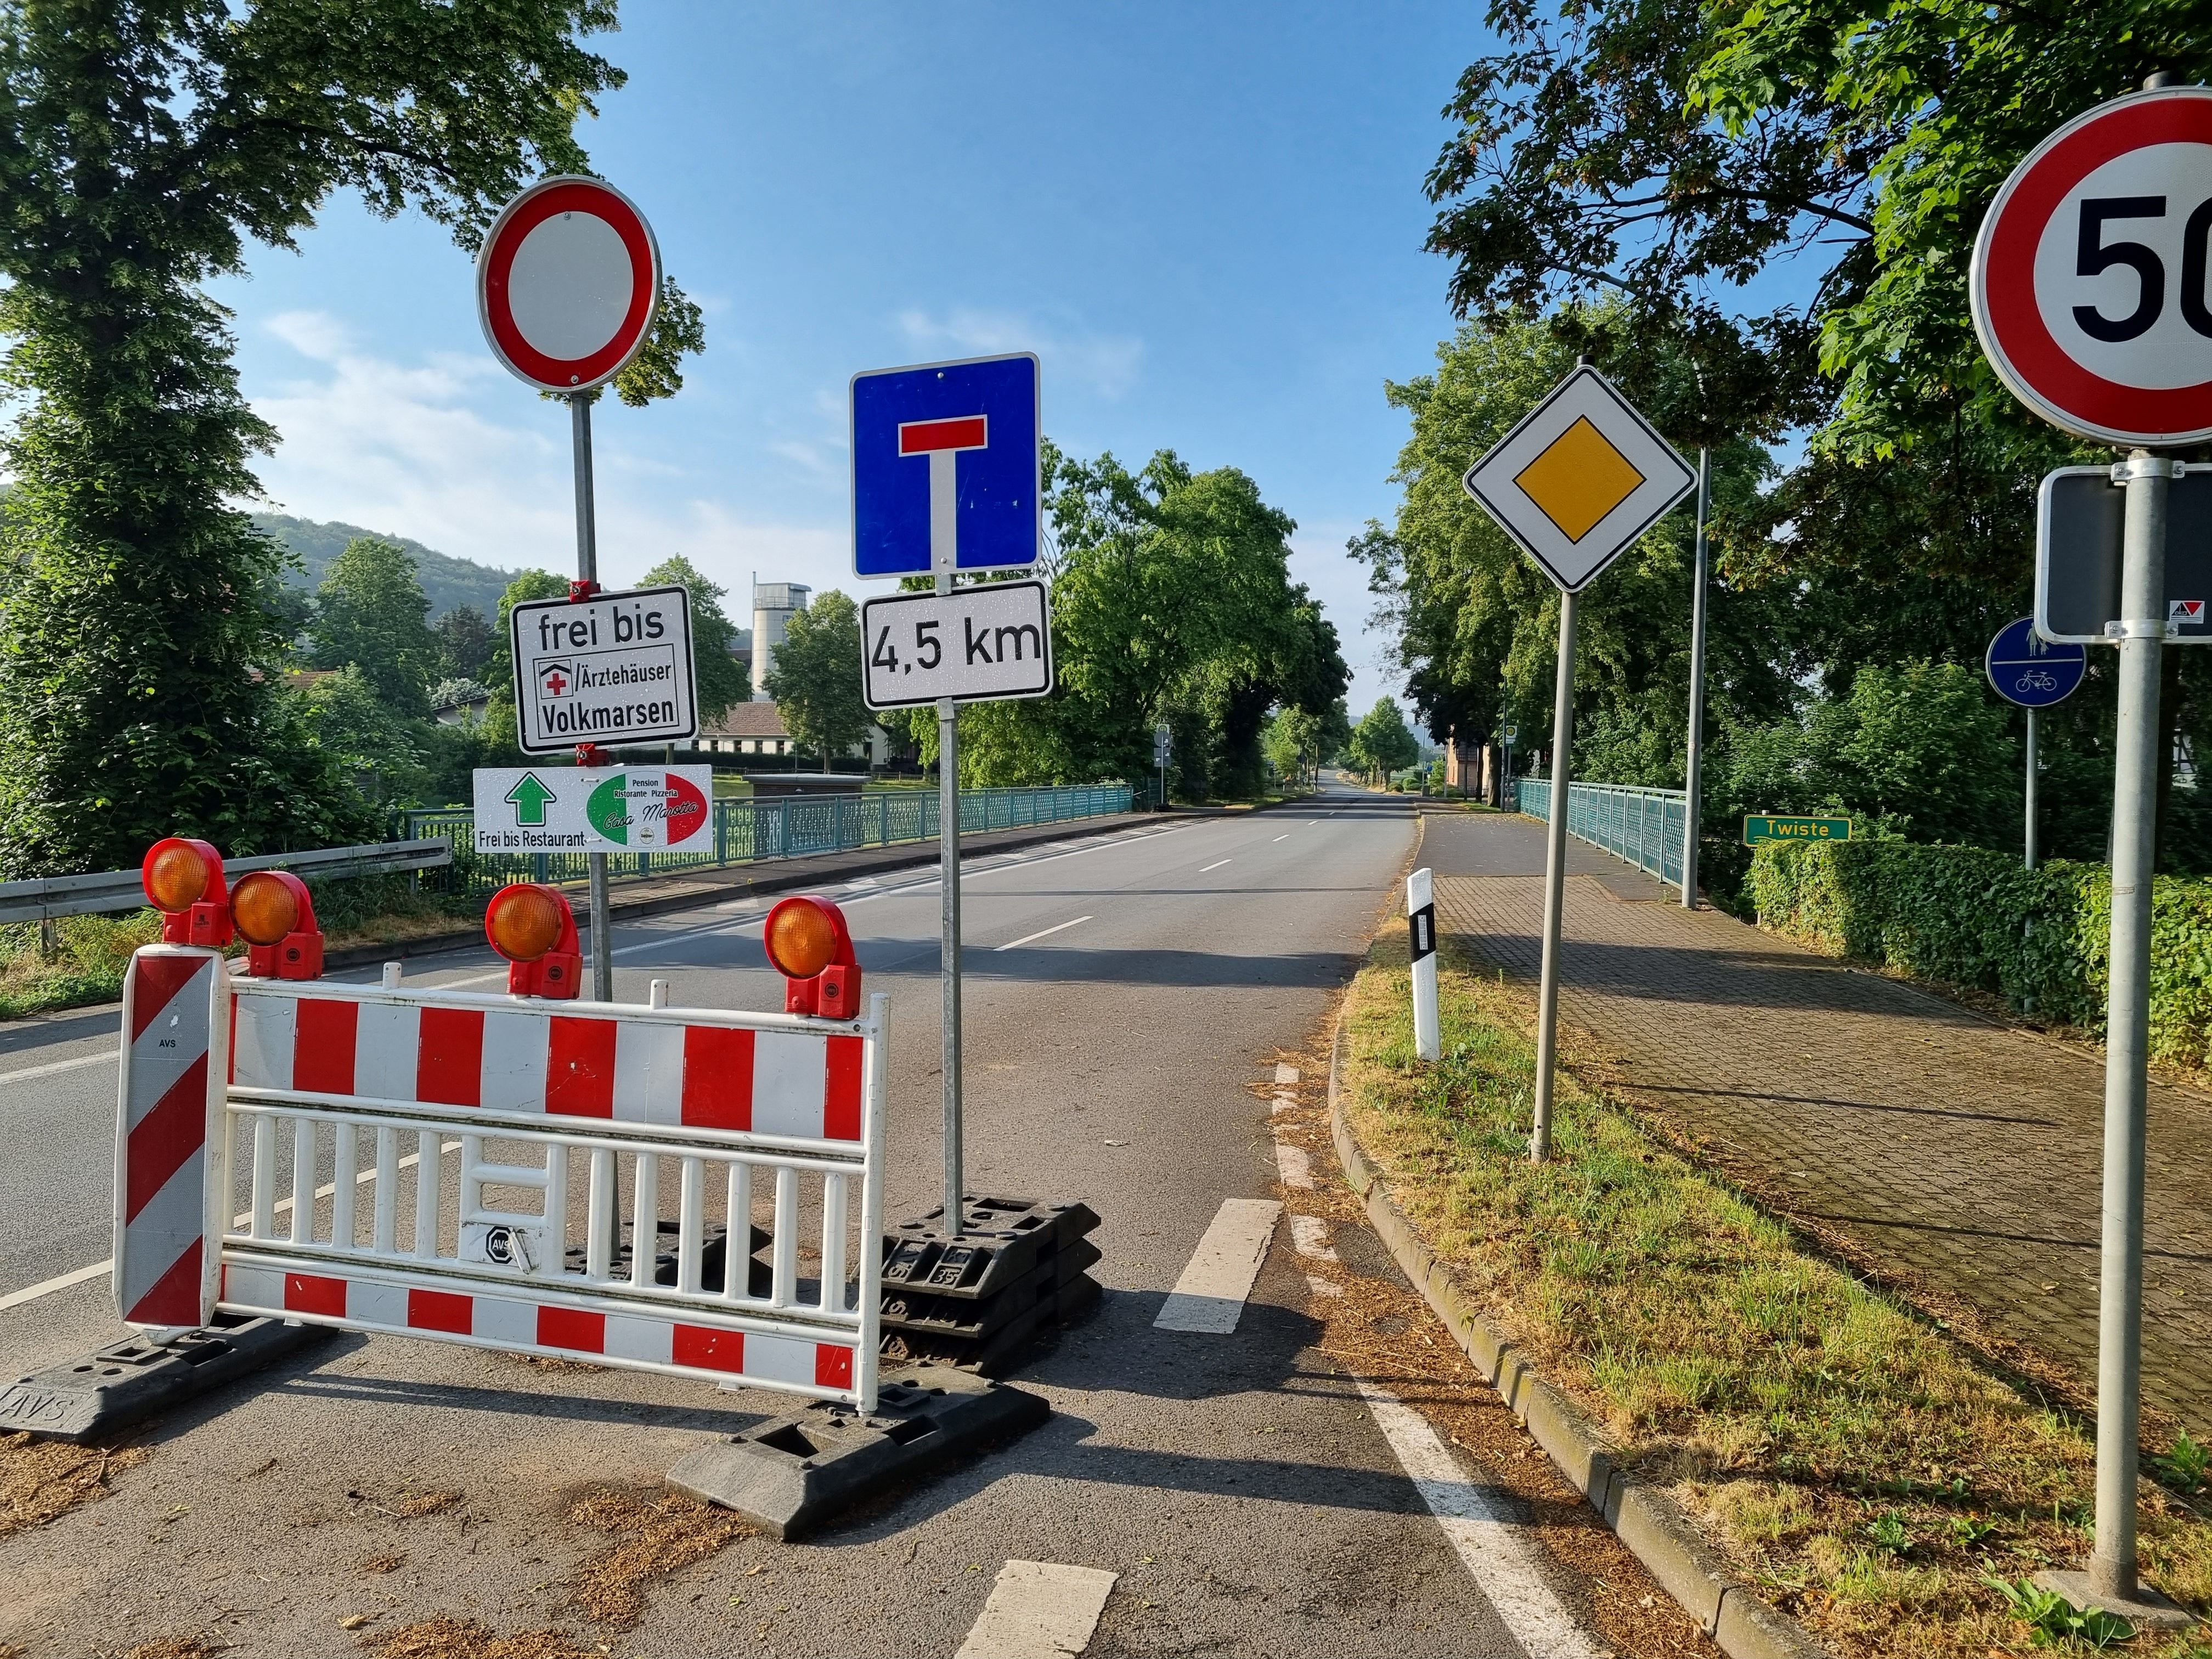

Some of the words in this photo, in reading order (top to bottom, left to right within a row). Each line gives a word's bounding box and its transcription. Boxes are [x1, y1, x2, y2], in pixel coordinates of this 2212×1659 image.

[539, 609, 597, 651] frei
[613, 603, 664, 643] bis
[872, 620, 941, 676] 4,5
[964, 617, 1041, 665] km
[541, 699, 674, 733] Volkmarsen
[603, 812, 634, 829] Casa
[642, 802, 698, 822] Marotta
[1767, 820, 1829, 837] Twiste
[479, 831, 500, 847] Frei
[504, 830, 520, 847] bis
[523, 830, 585, 847] Restaurant
[159, 1039, 176, 1048] AVS
[0, 1394, 74, 1421] AVS
